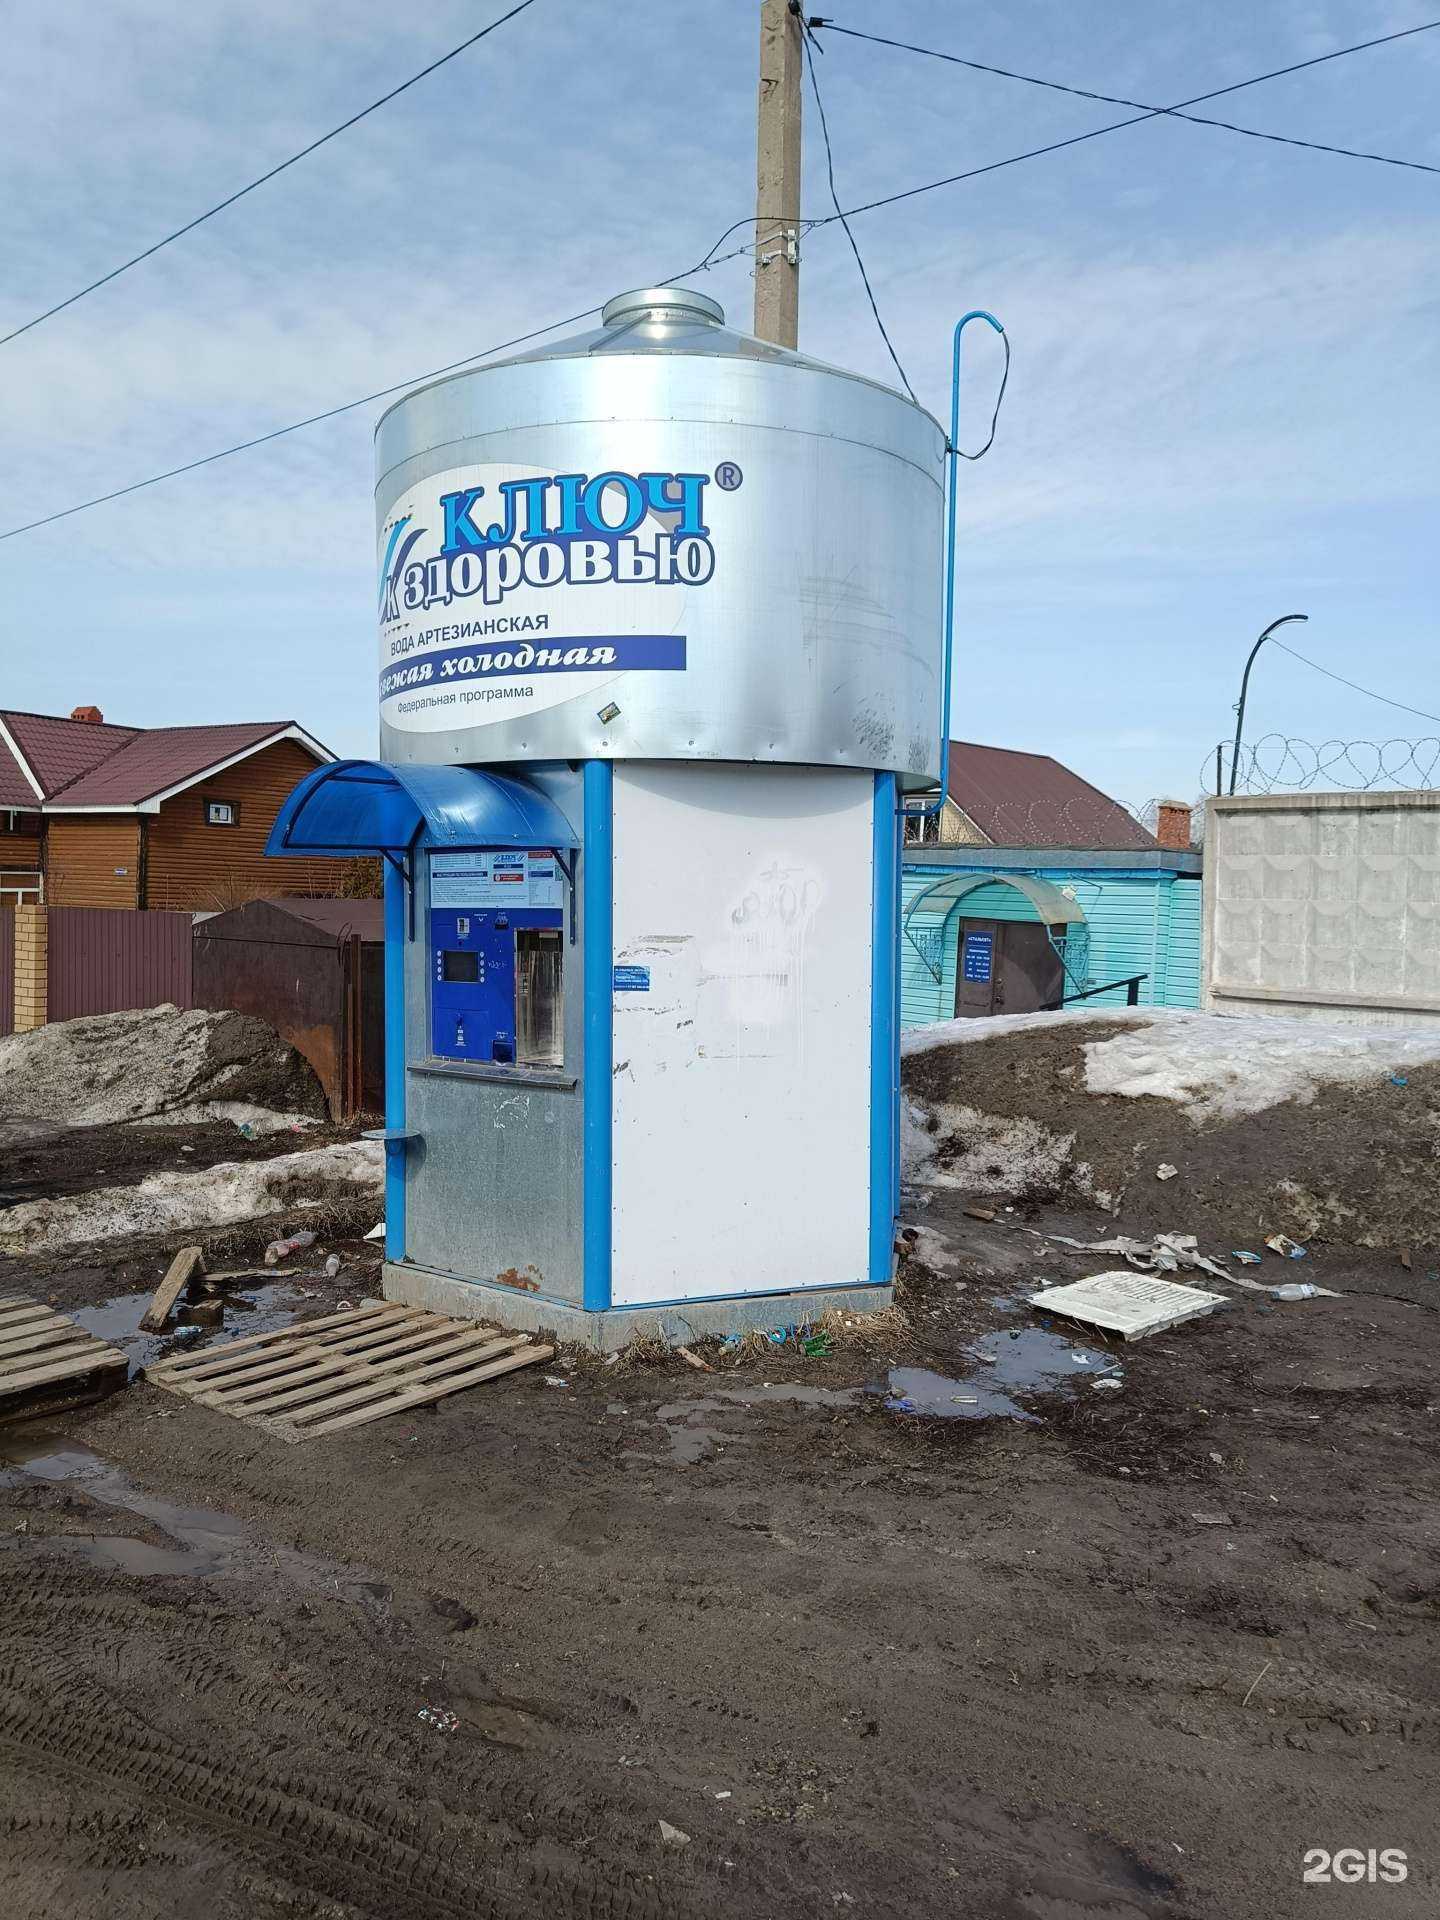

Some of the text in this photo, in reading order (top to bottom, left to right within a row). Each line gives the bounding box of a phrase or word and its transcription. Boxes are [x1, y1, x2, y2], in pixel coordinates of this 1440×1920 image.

[440, 471, 710, 552] КЛЮЧ
[404, 532, 716, 611] здоровью
[390, 614, 549, 657] ВОДА АРТЕЗИАНСКАЯ
[440, 643, 617, 677] холодная
[397, 686, 534, 714] Федеральная программа
